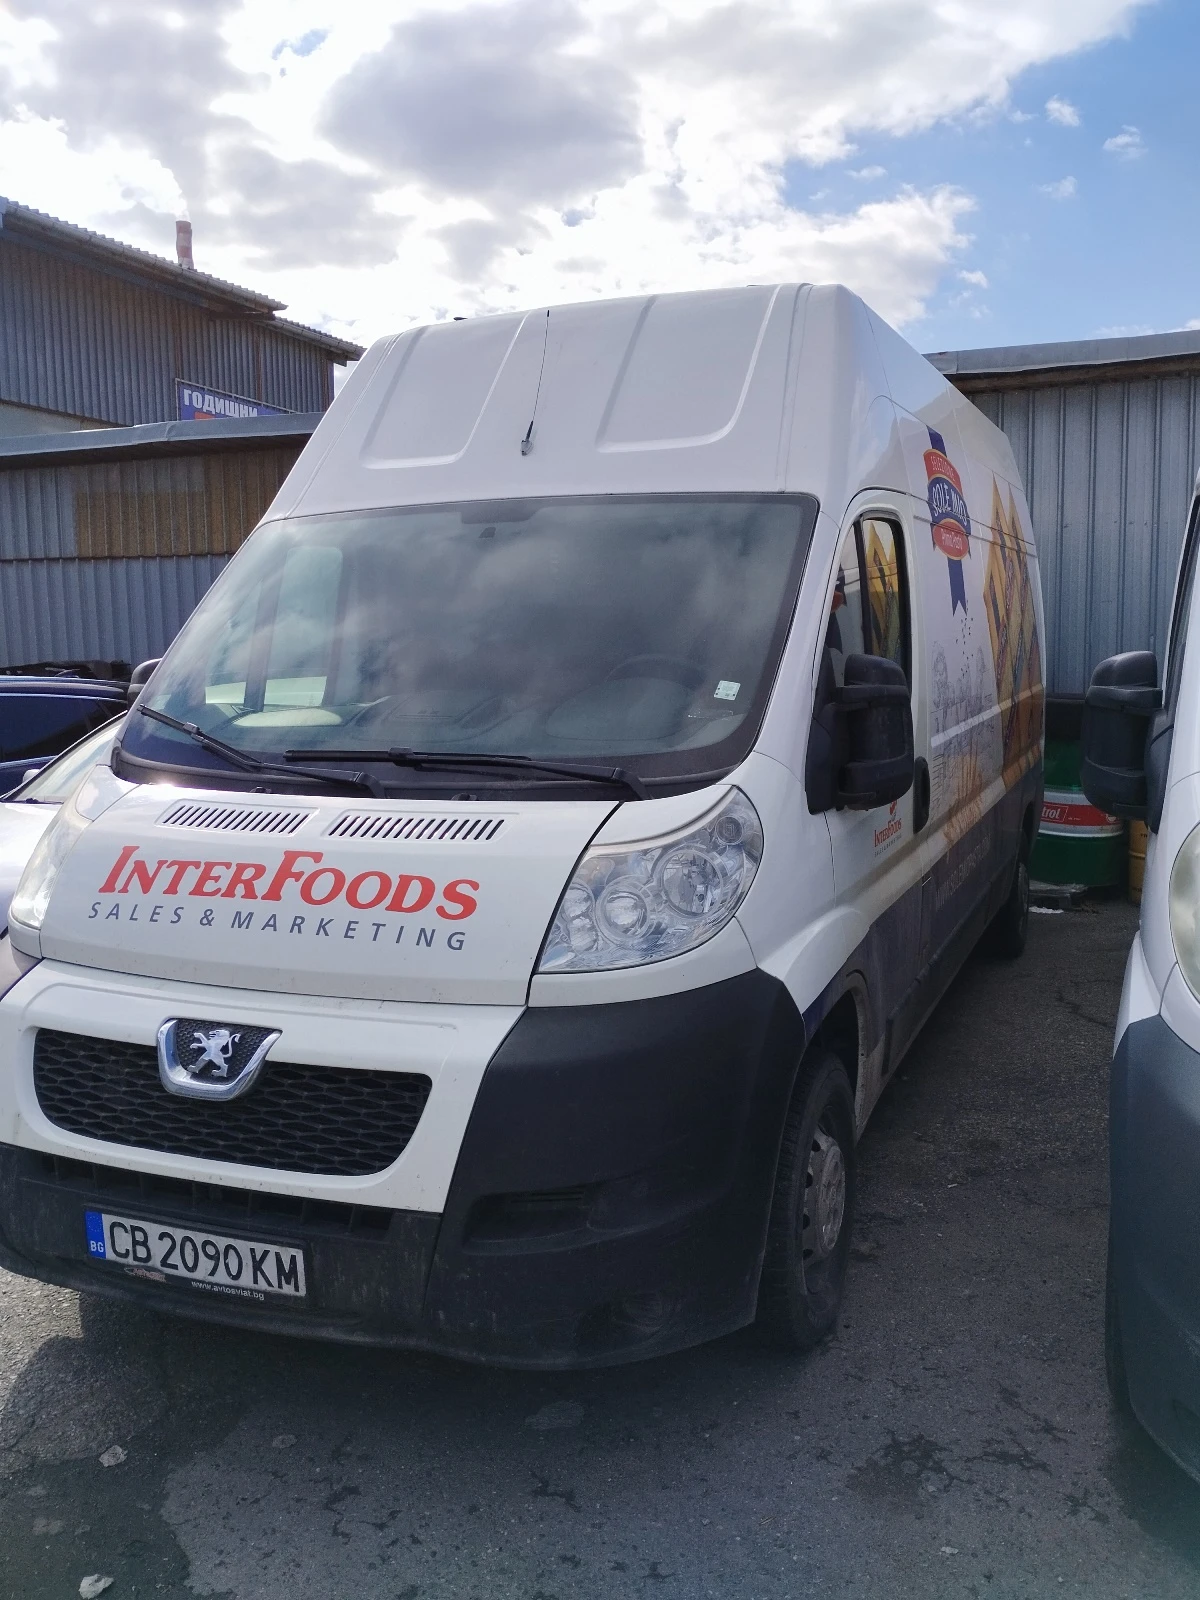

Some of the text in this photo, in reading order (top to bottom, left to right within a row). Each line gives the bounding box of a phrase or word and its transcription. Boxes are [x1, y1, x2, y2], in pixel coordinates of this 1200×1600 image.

[183, 388, 258, 418] ГОДИШНИ
[932, 482, 951, 517] SOLE
[1041, 807, 1060, 820] trol
[98, 845, 480, 921] INTERFOODS
[87, 901, 466, 951] SALES & MARKETING
[90, 1241, 104, 1253] BG
